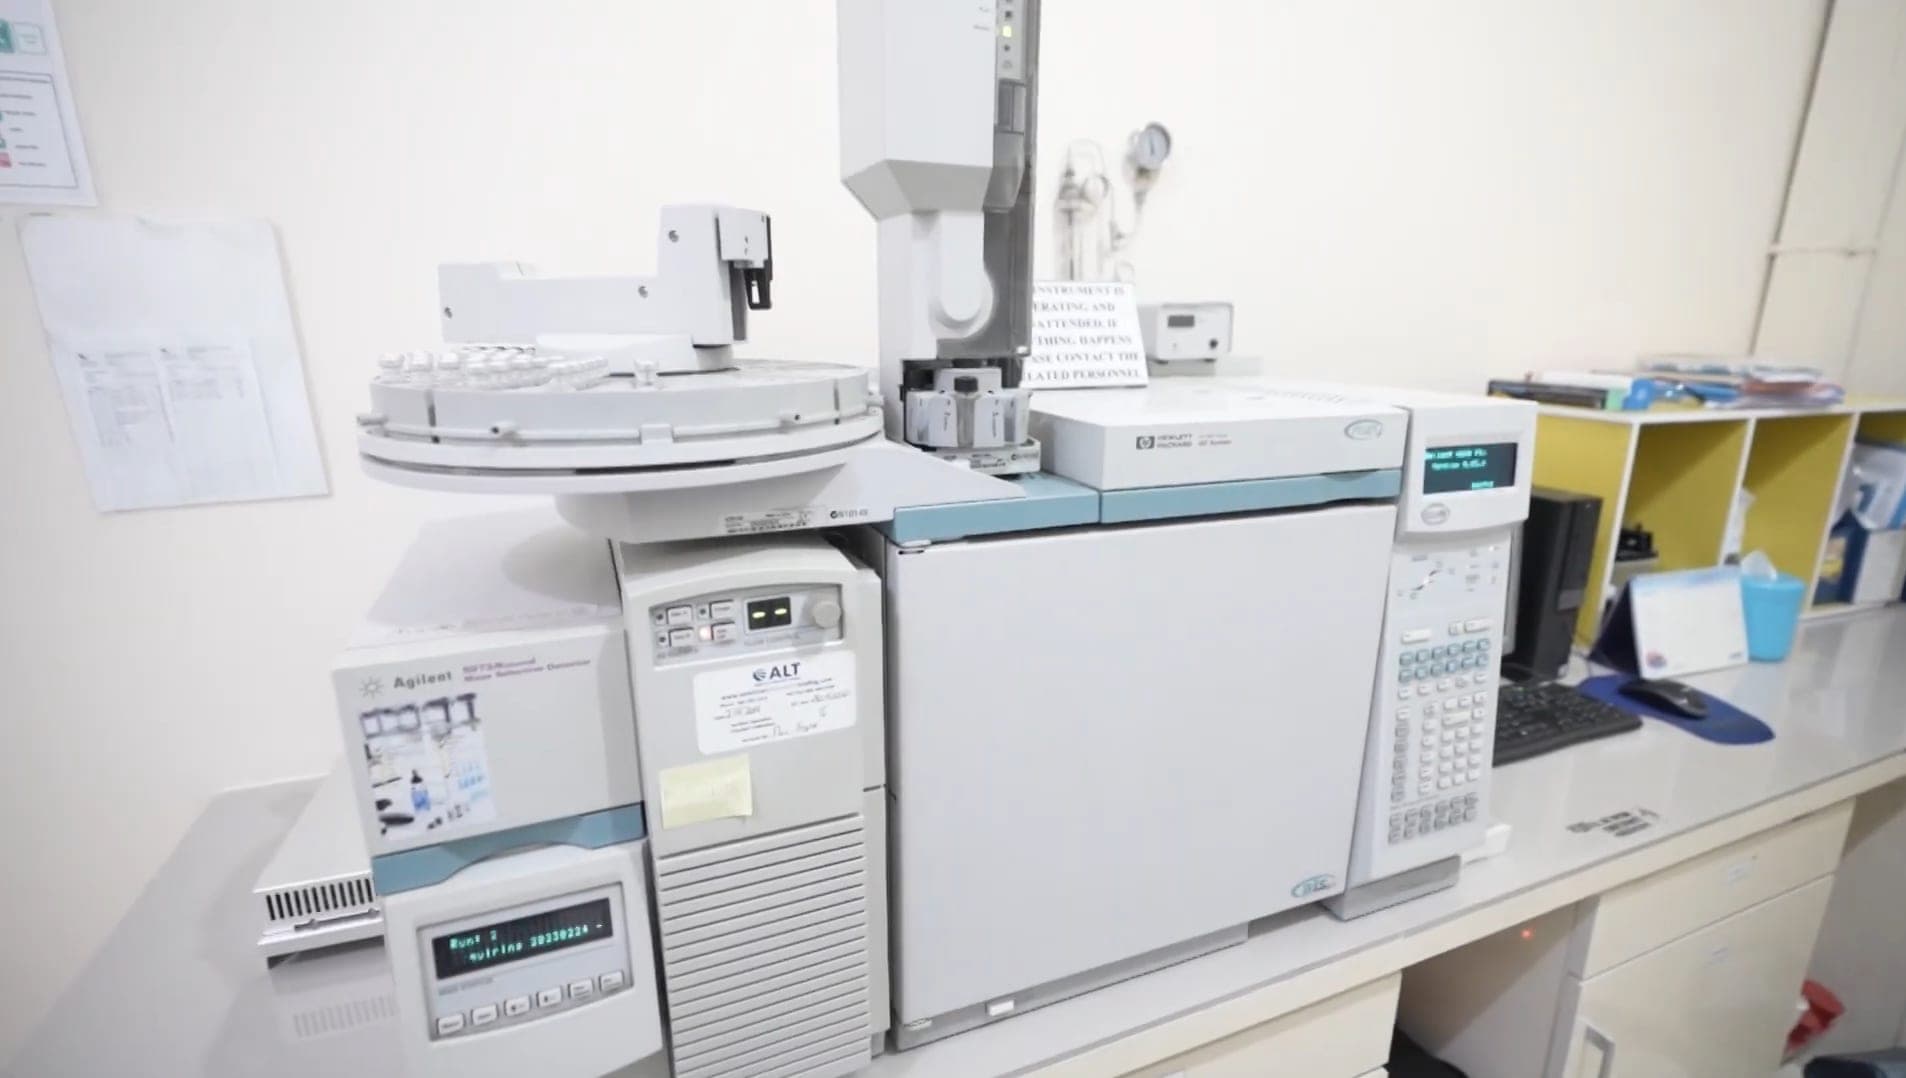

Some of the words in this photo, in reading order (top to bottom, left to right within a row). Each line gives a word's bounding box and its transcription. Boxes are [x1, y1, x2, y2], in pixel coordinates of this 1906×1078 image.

[1033, 302, 1087, 313] ERATING
[1092, 303, 1116, 313] AND
[1107, 320, 1118, 329] IF
[1037, 335, 1076, 346] THING
[1079, 335, 1133, 345] HAPPENS
[1031, 354, 1051, 363] ASE
[1056, 351, 1114, 362] CONTACT
[1118, 351, 1139, 361] THE
[1022, 370, 1070, 382] LATED
[1072, 368, 1140, 380] PERSONNEL
[769, 662, 801, 680] ALT
[393, 671, 453, 689] Agilent
